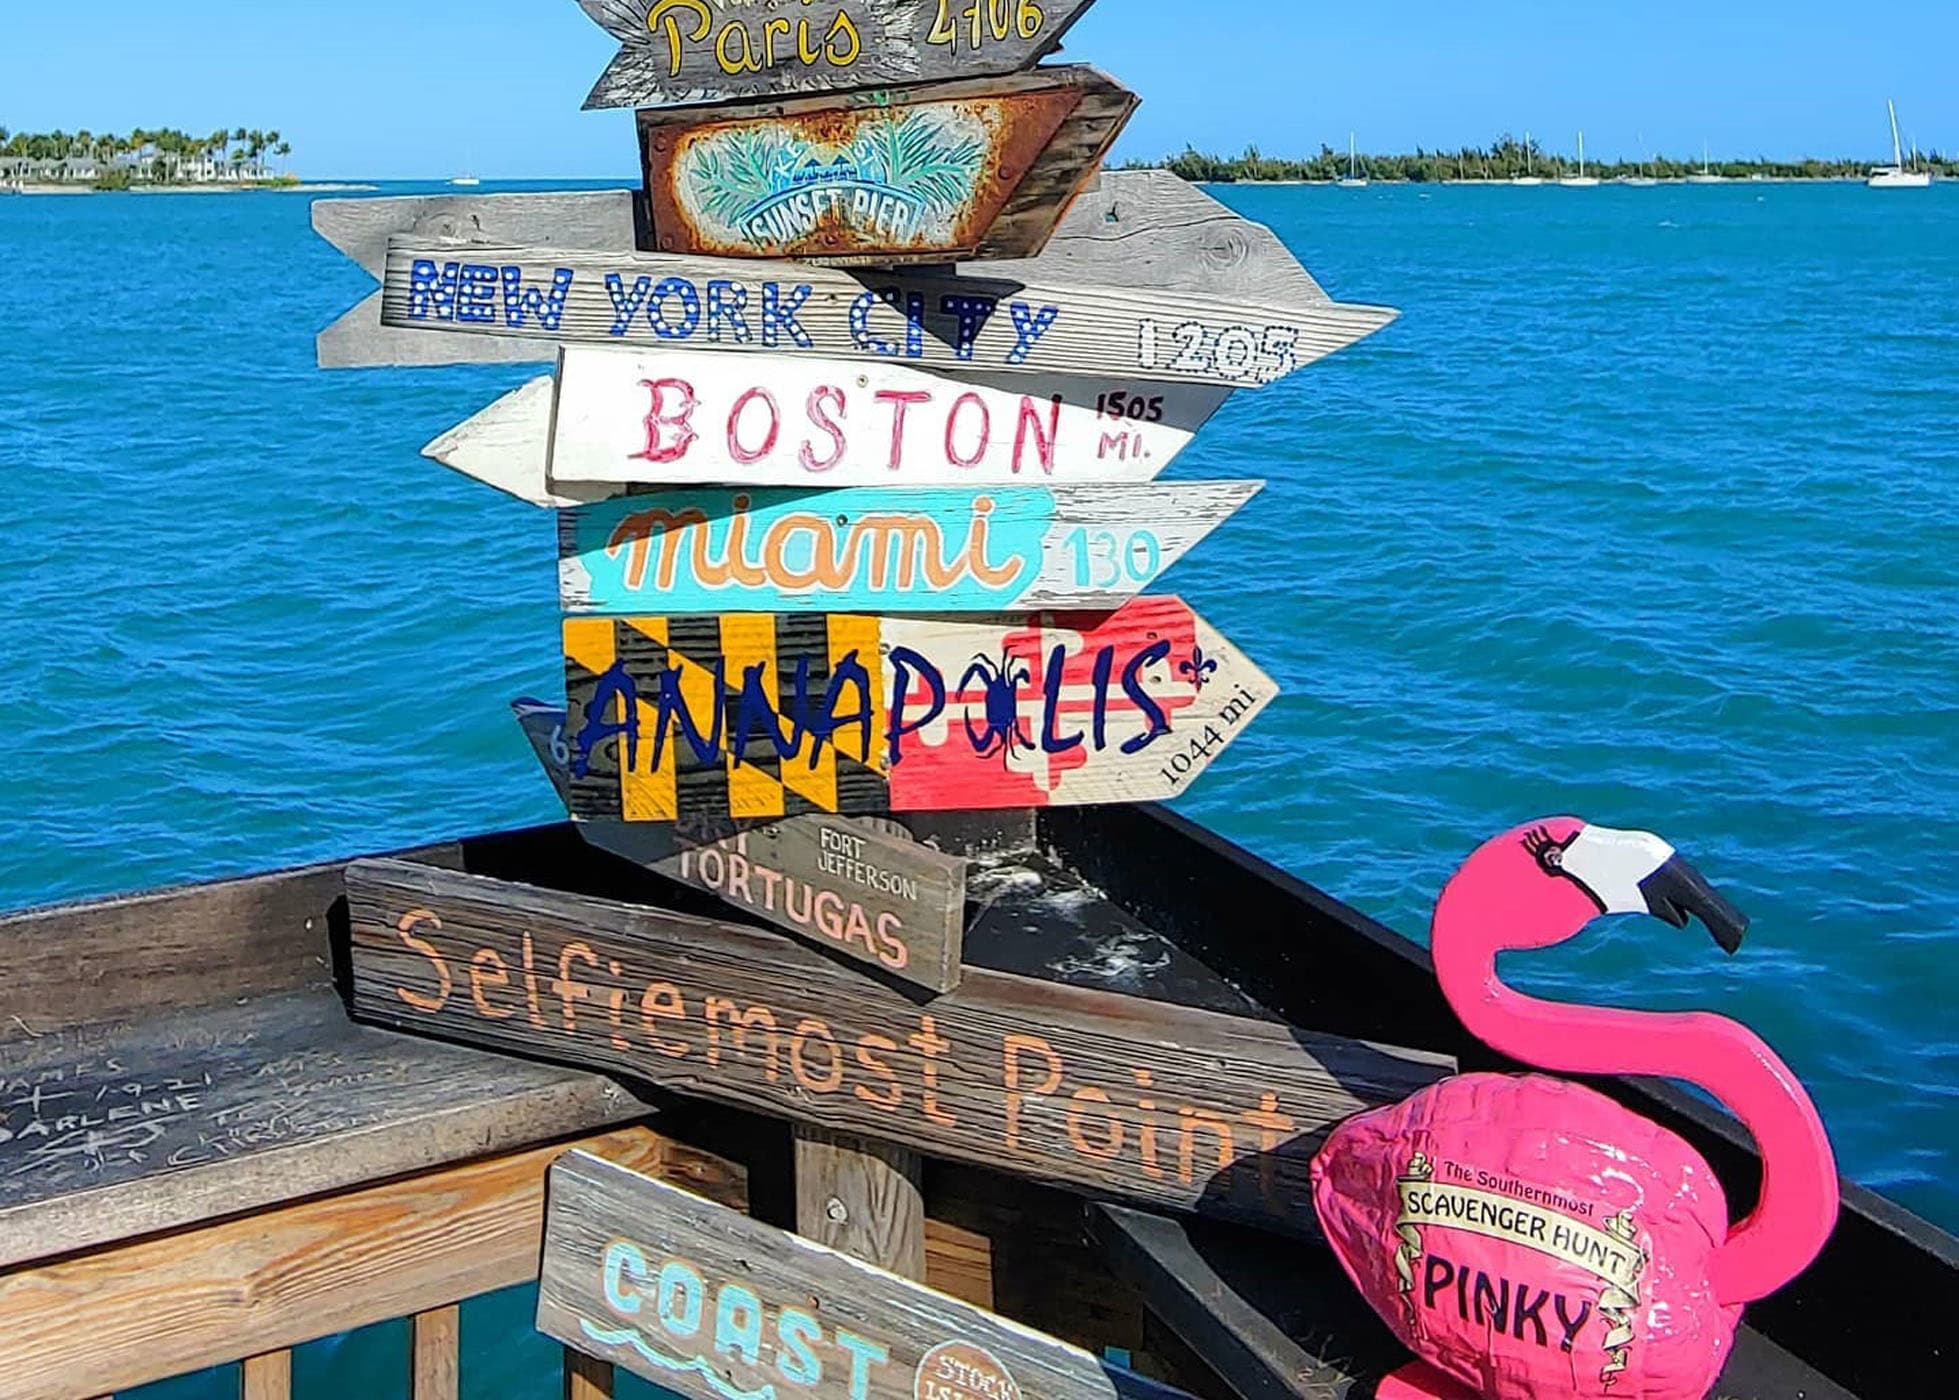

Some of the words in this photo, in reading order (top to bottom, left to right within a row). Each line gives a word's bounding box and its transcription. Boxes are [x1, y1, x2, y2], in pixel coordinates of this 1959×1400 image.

[646, 0, 862, 77] Paris
[926, 0, 1045, 55] 4706
[750, 186, 843, 247] SUNSET
[850, 187, 912, 242] PIER
[408, 259, 574, 331] NEW
[603, 273, 813, 348] YORK
[850, 287, 1059, 364] CITY
[1137, 317, 1299, 384] 1205
[627, 377, 1063, 476] BOSTON
[1096, 389, 1164, 422] 1505
[606, 493, 1024, 590] miami
[1063, 526, 1162, 587] 130
[575, 638, 1175, 780] ANNAPOLIS
[1160, 724, 1224, 786] 1044
[1218, 683, 1257, 725] mi
[817, 850, 918, 901] JEFFERSON
[820, 826, 867, 860] FORT
[676, 836, 909, 970] TORTUGAS
[397, 907, 955, 1128] Selfiemost
[1003, 1032, 1295, 1206] Point
[1408, 1191, 1547, 1242] SCAVENGER
[1551, 1225, 1628, 1275] HUNT
[1443, 1161, 1473, 1182] The
[1478, 1170, 1595, 1217] Southernmost
[601, 1239, 891, 1400] COAST
[1424, 1255, 1593, 1353] PINKY
